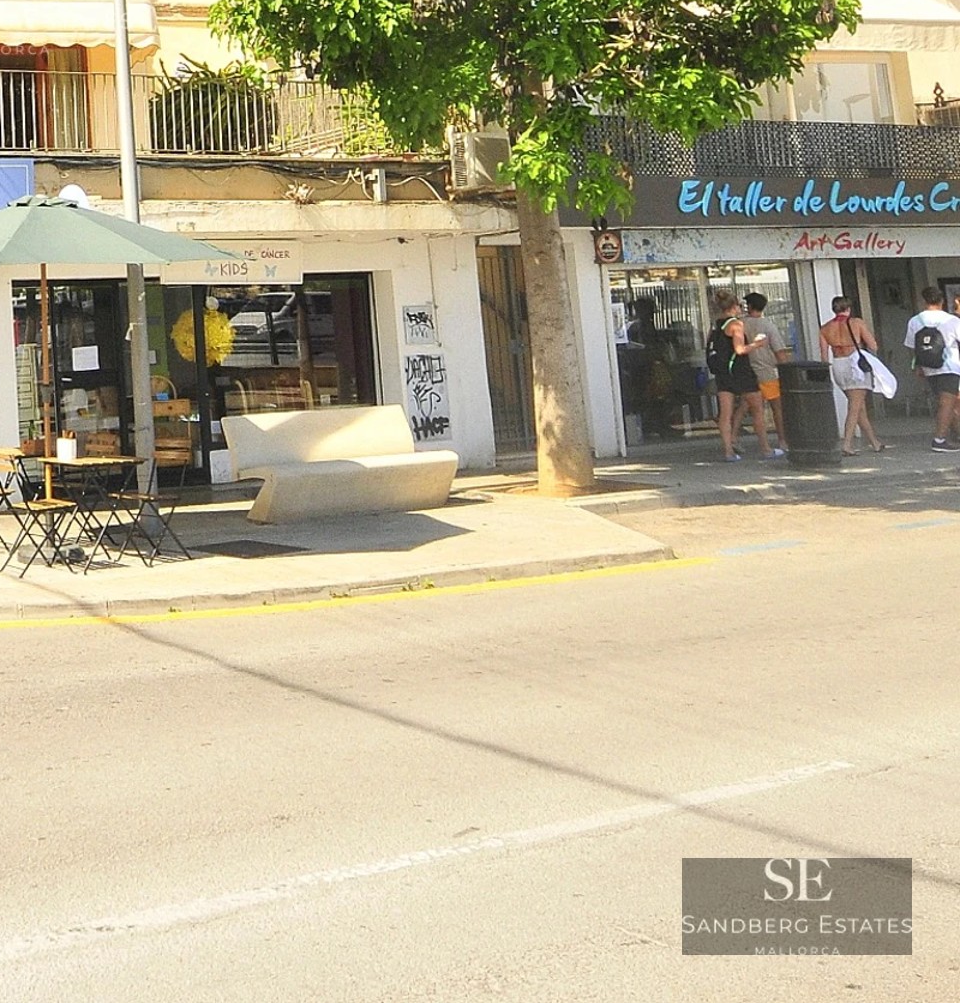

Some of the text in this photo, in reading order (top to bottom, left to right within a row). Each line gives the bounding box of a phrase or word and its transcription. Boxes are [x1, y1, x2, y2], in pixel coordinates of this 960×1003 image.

[678, 179, 713, 216] El
[717, 180, 787, 217] taller
[794, 179, 826, 213] de
[828, 180, 925, 217] Lourdes
[793, 231, 907, 255] Art Gallery
[220, 260, 248, 276] KIDS
